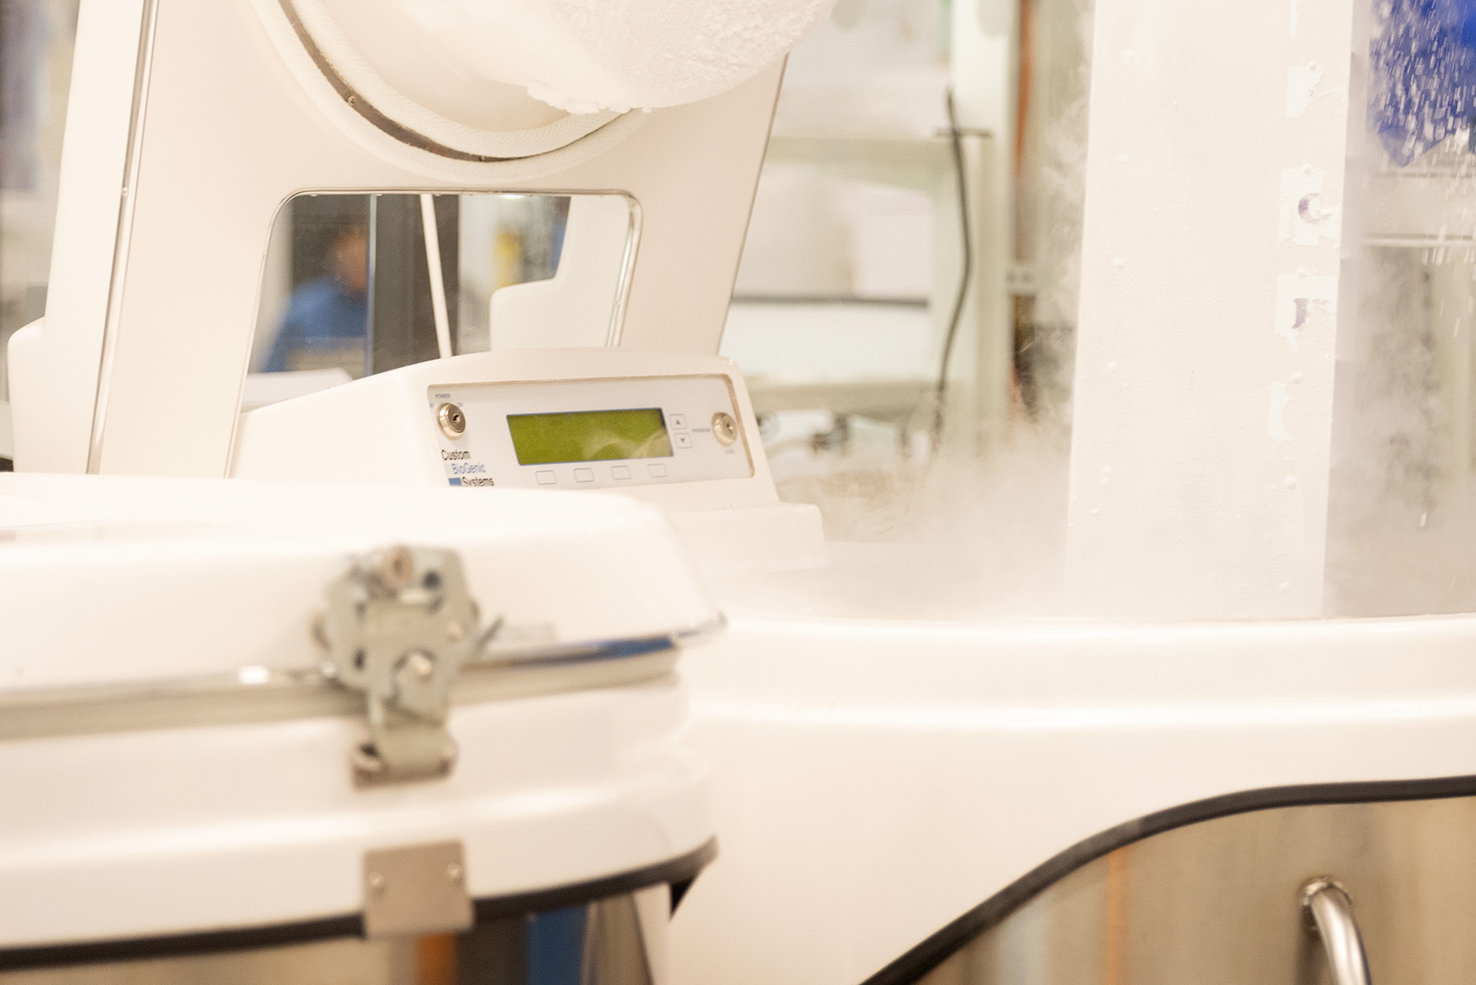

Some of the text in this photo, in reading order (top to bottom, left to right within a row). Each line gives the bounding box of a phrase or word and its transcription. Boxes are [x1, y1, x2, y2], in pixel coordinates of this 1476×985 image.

[441, 449, 471, 461] Custom
[451, 462, 486, 474] BioGenic
[462, 476, 494, 487] Systems
